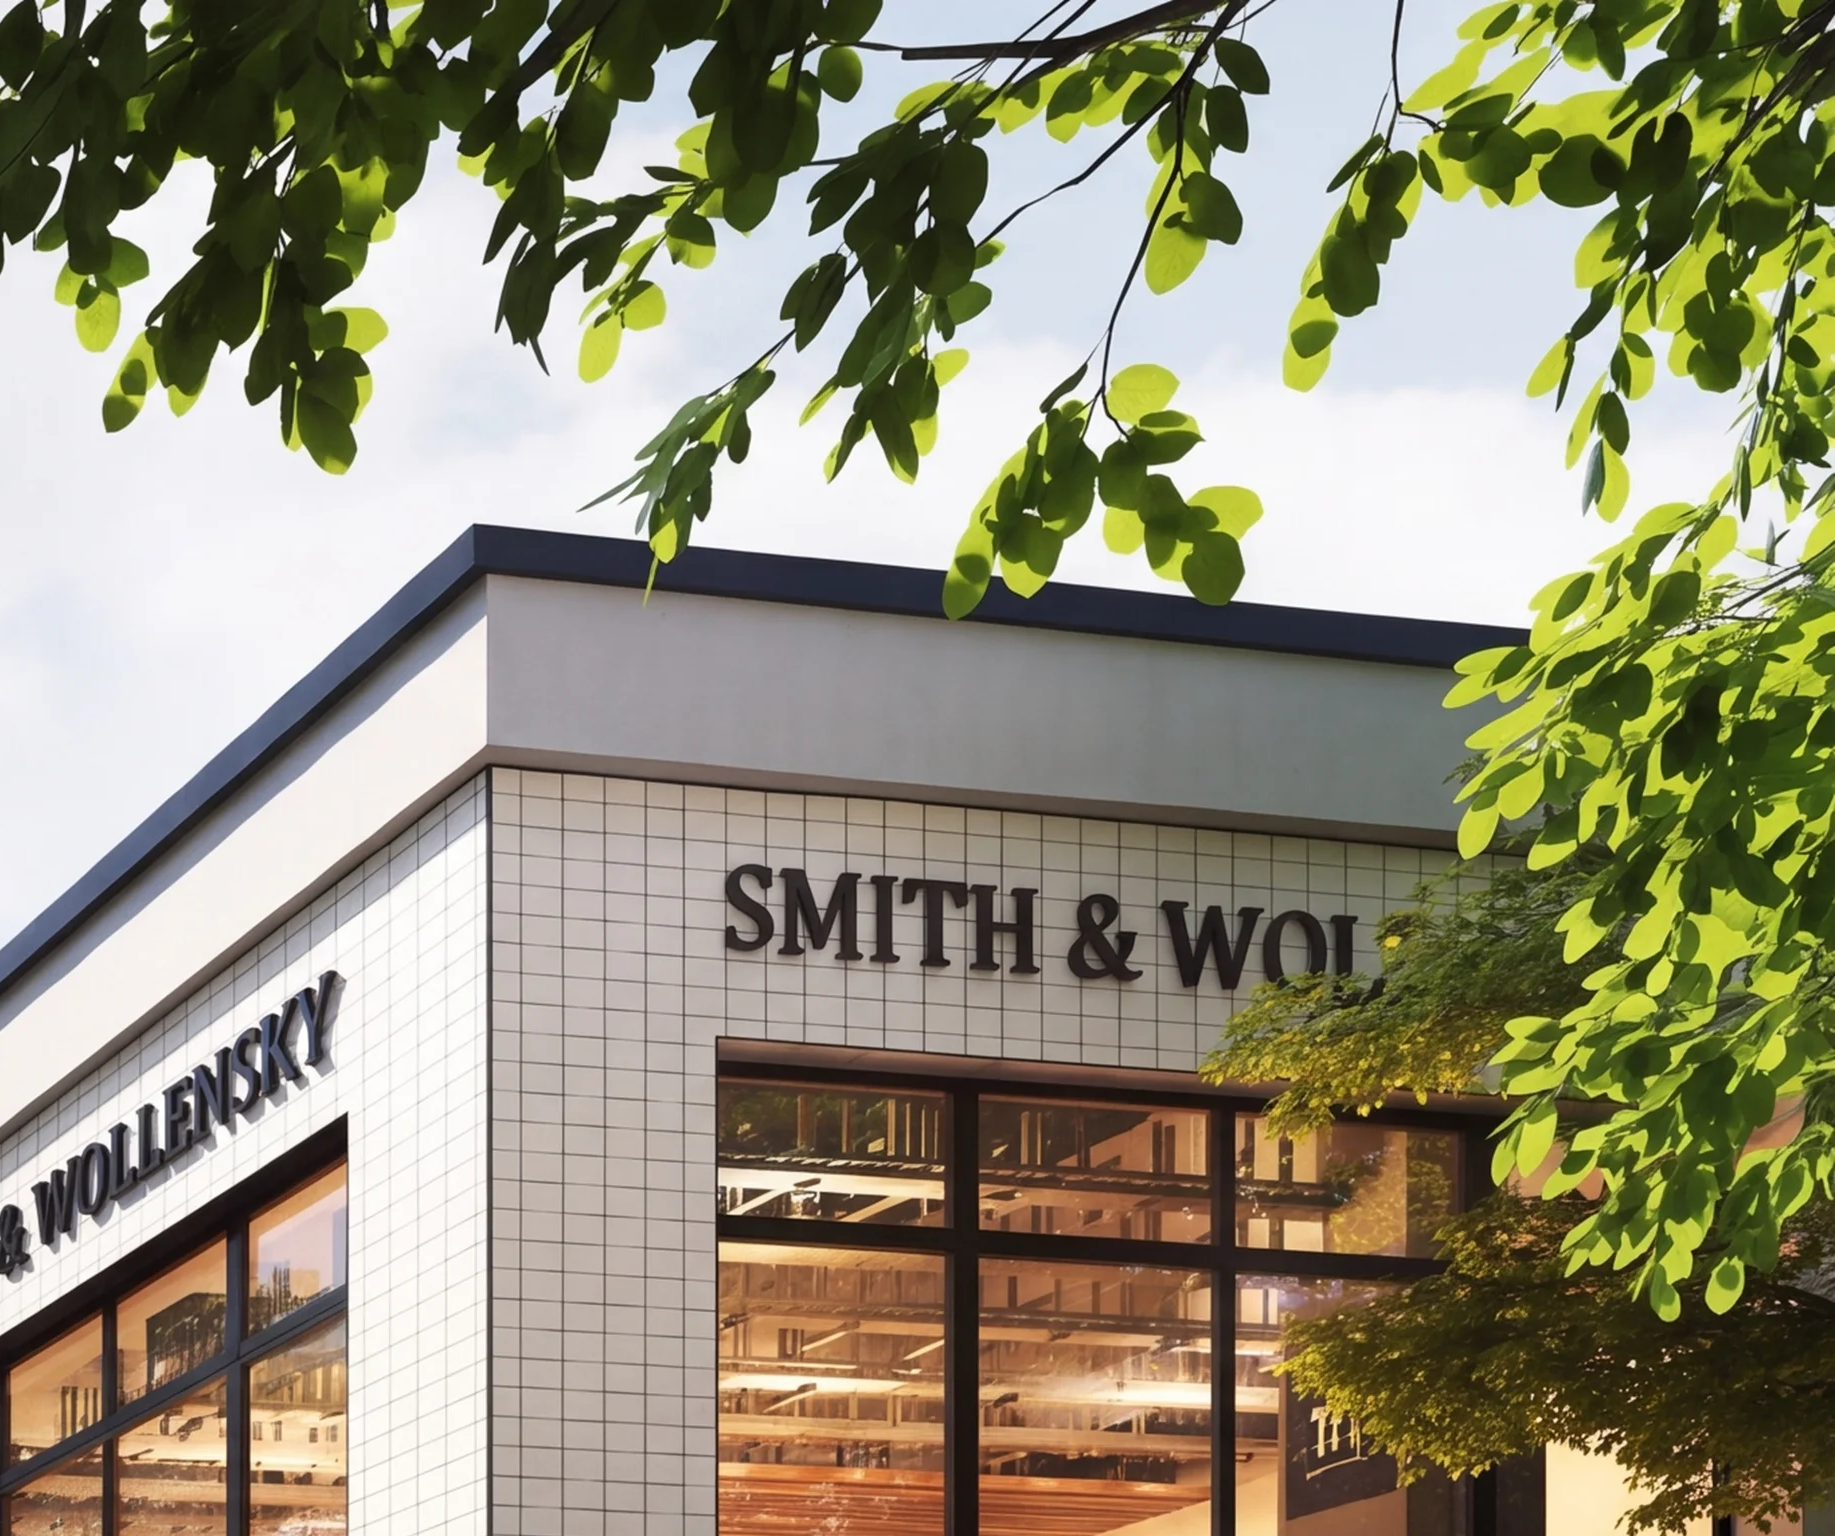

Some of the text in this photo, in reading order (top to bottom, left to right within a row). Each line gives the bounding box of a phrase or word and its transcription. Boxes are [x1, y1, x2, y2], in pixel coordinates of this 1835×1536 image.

[725, 863, 1040, 975] SMITH
[1067, 893, 1143, 982] &
[31, 970, 345, 1245] WOLLENSKY
